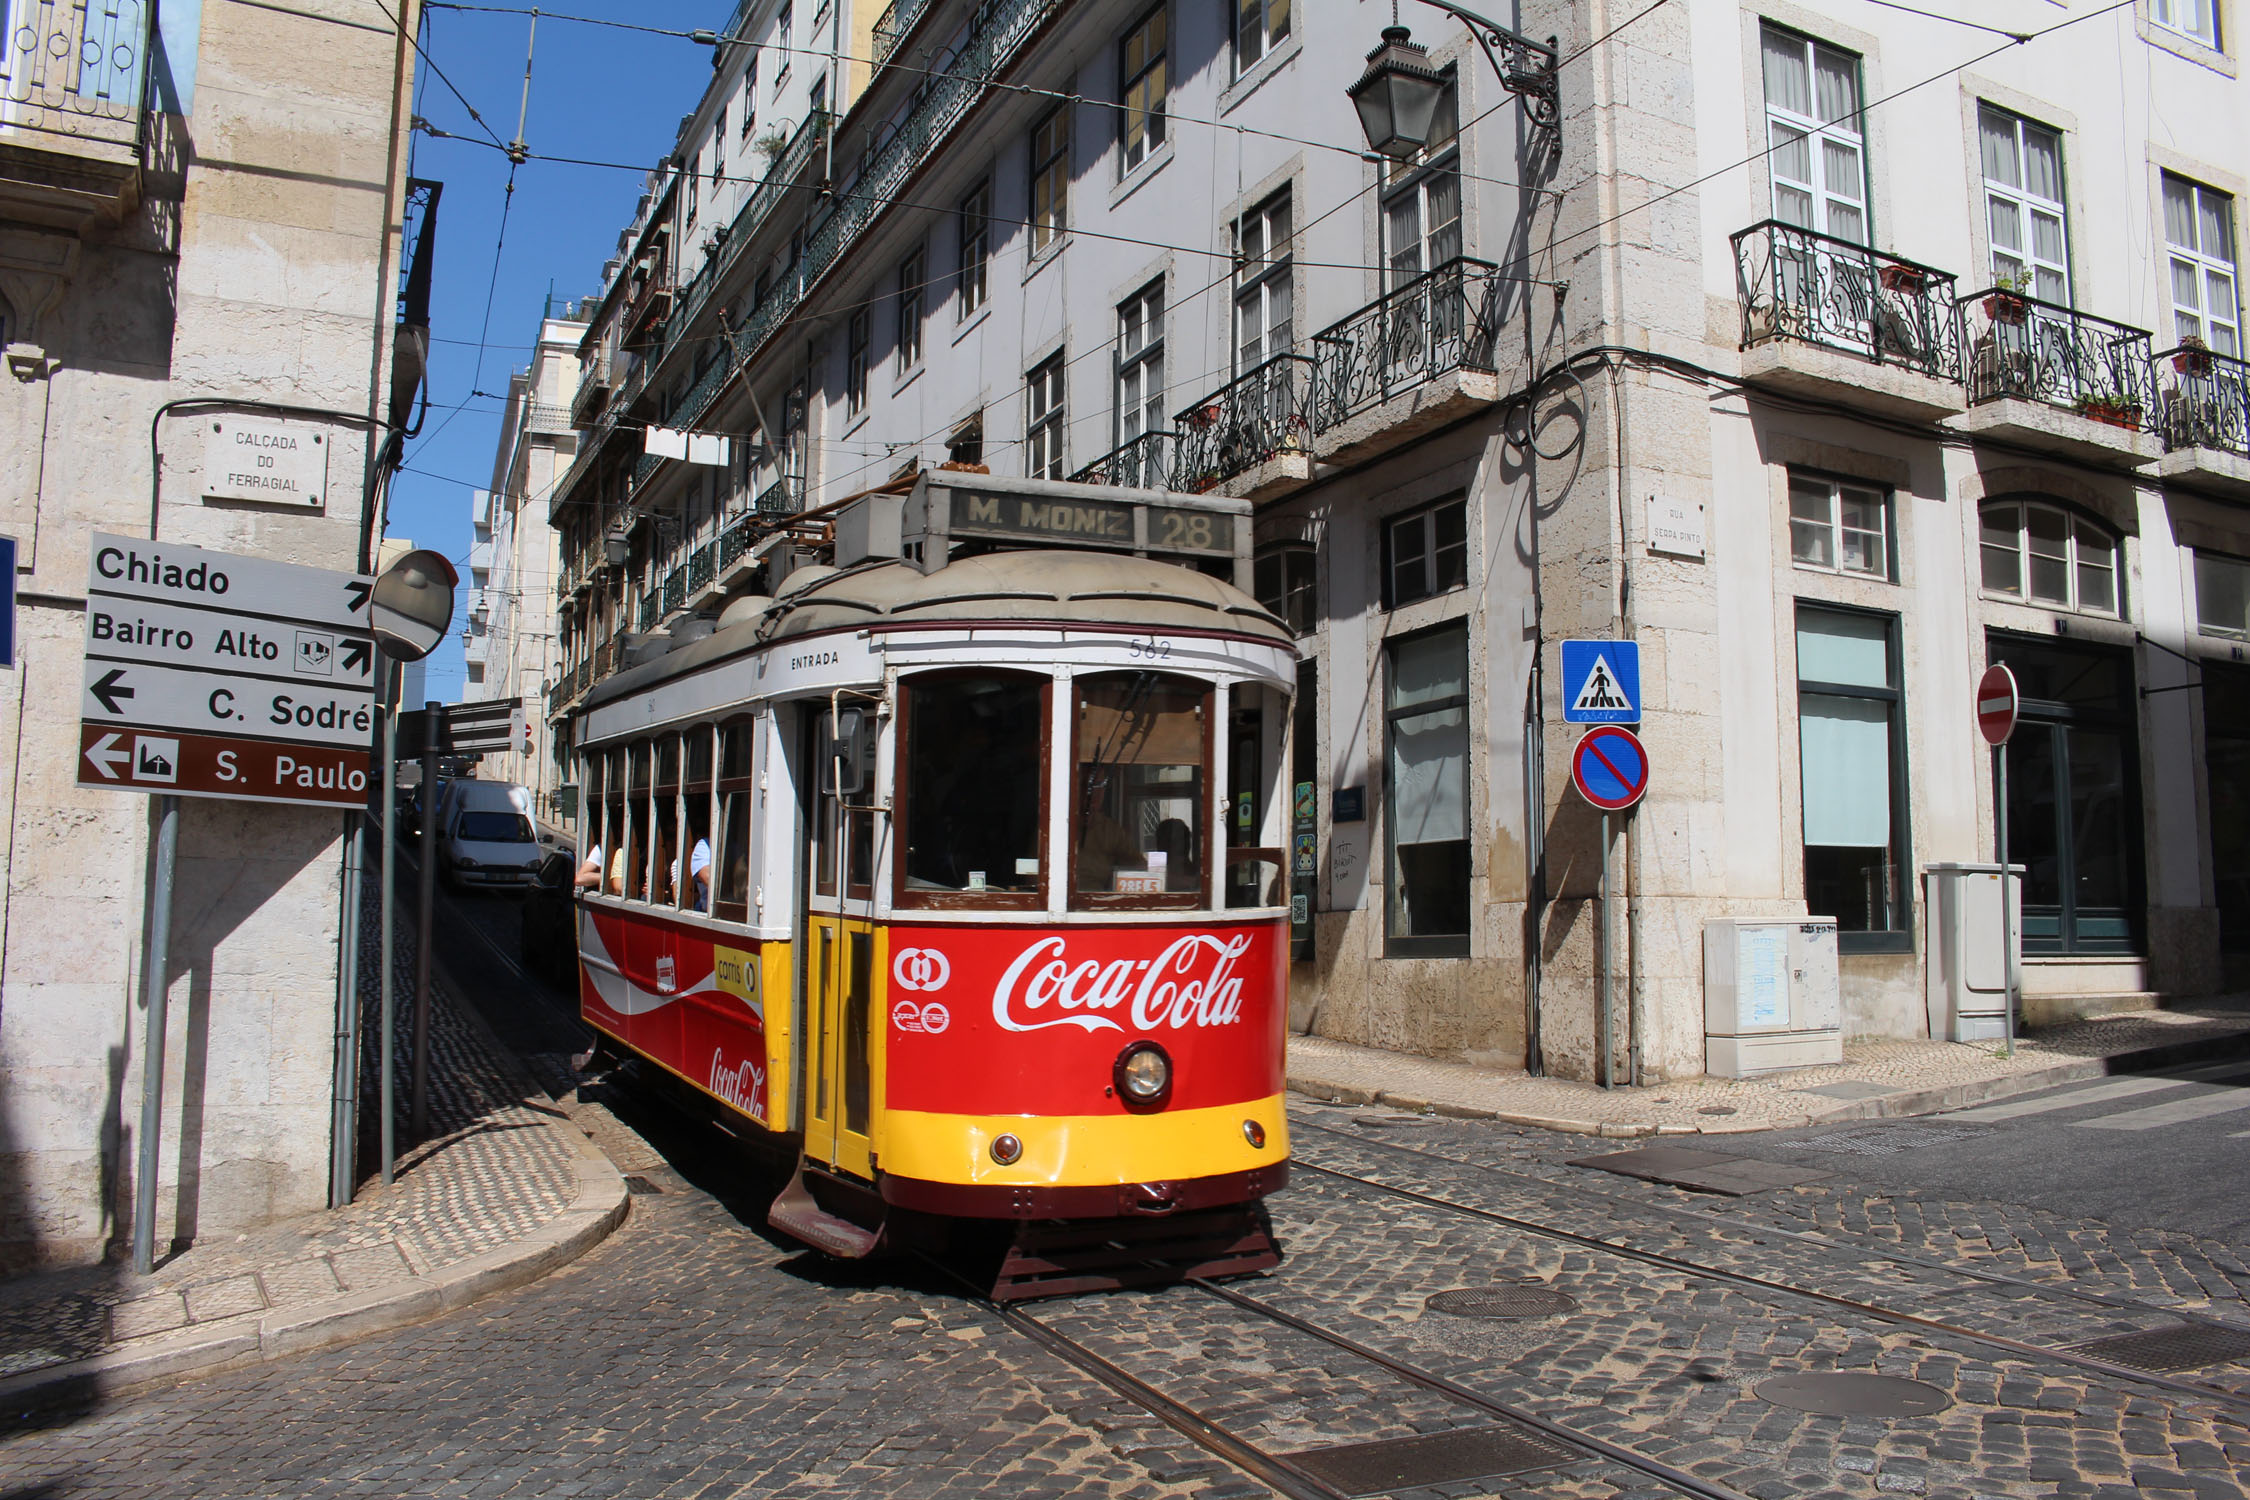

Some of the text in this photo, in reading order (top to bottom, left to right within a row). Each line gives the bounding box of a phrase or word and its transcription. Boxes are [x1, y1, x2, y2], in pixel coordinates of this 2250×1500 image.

[236, 432, 298, 450] CALÇADA
[257, 455, 274, 468] DO
[228, 473, 299, 492] FERRAGIAL
[968, 495, 1129, 536] M. MONIZ
[1669, 509, 1684, 519] RUA
[1160, 512, 1213, 549] 28
[1654, 528, 1701, 544] SERPA PINTO
[96, 547, 229, 594] Chiado
[92, 612, 279, 660] Bairro Alto
[1130, 639, 1171, 659] 562
[792, 651, 839, 670] ENTRADA
[209, 688, 370, 732] C. Sodré
[215, 750, 367, 792] S. Paulo
[718, 956, 741, 984] carris
[993, 933, 1254, 1033] Coca-Cola
[710, 1047, 766, 1119] Coca-Cola
